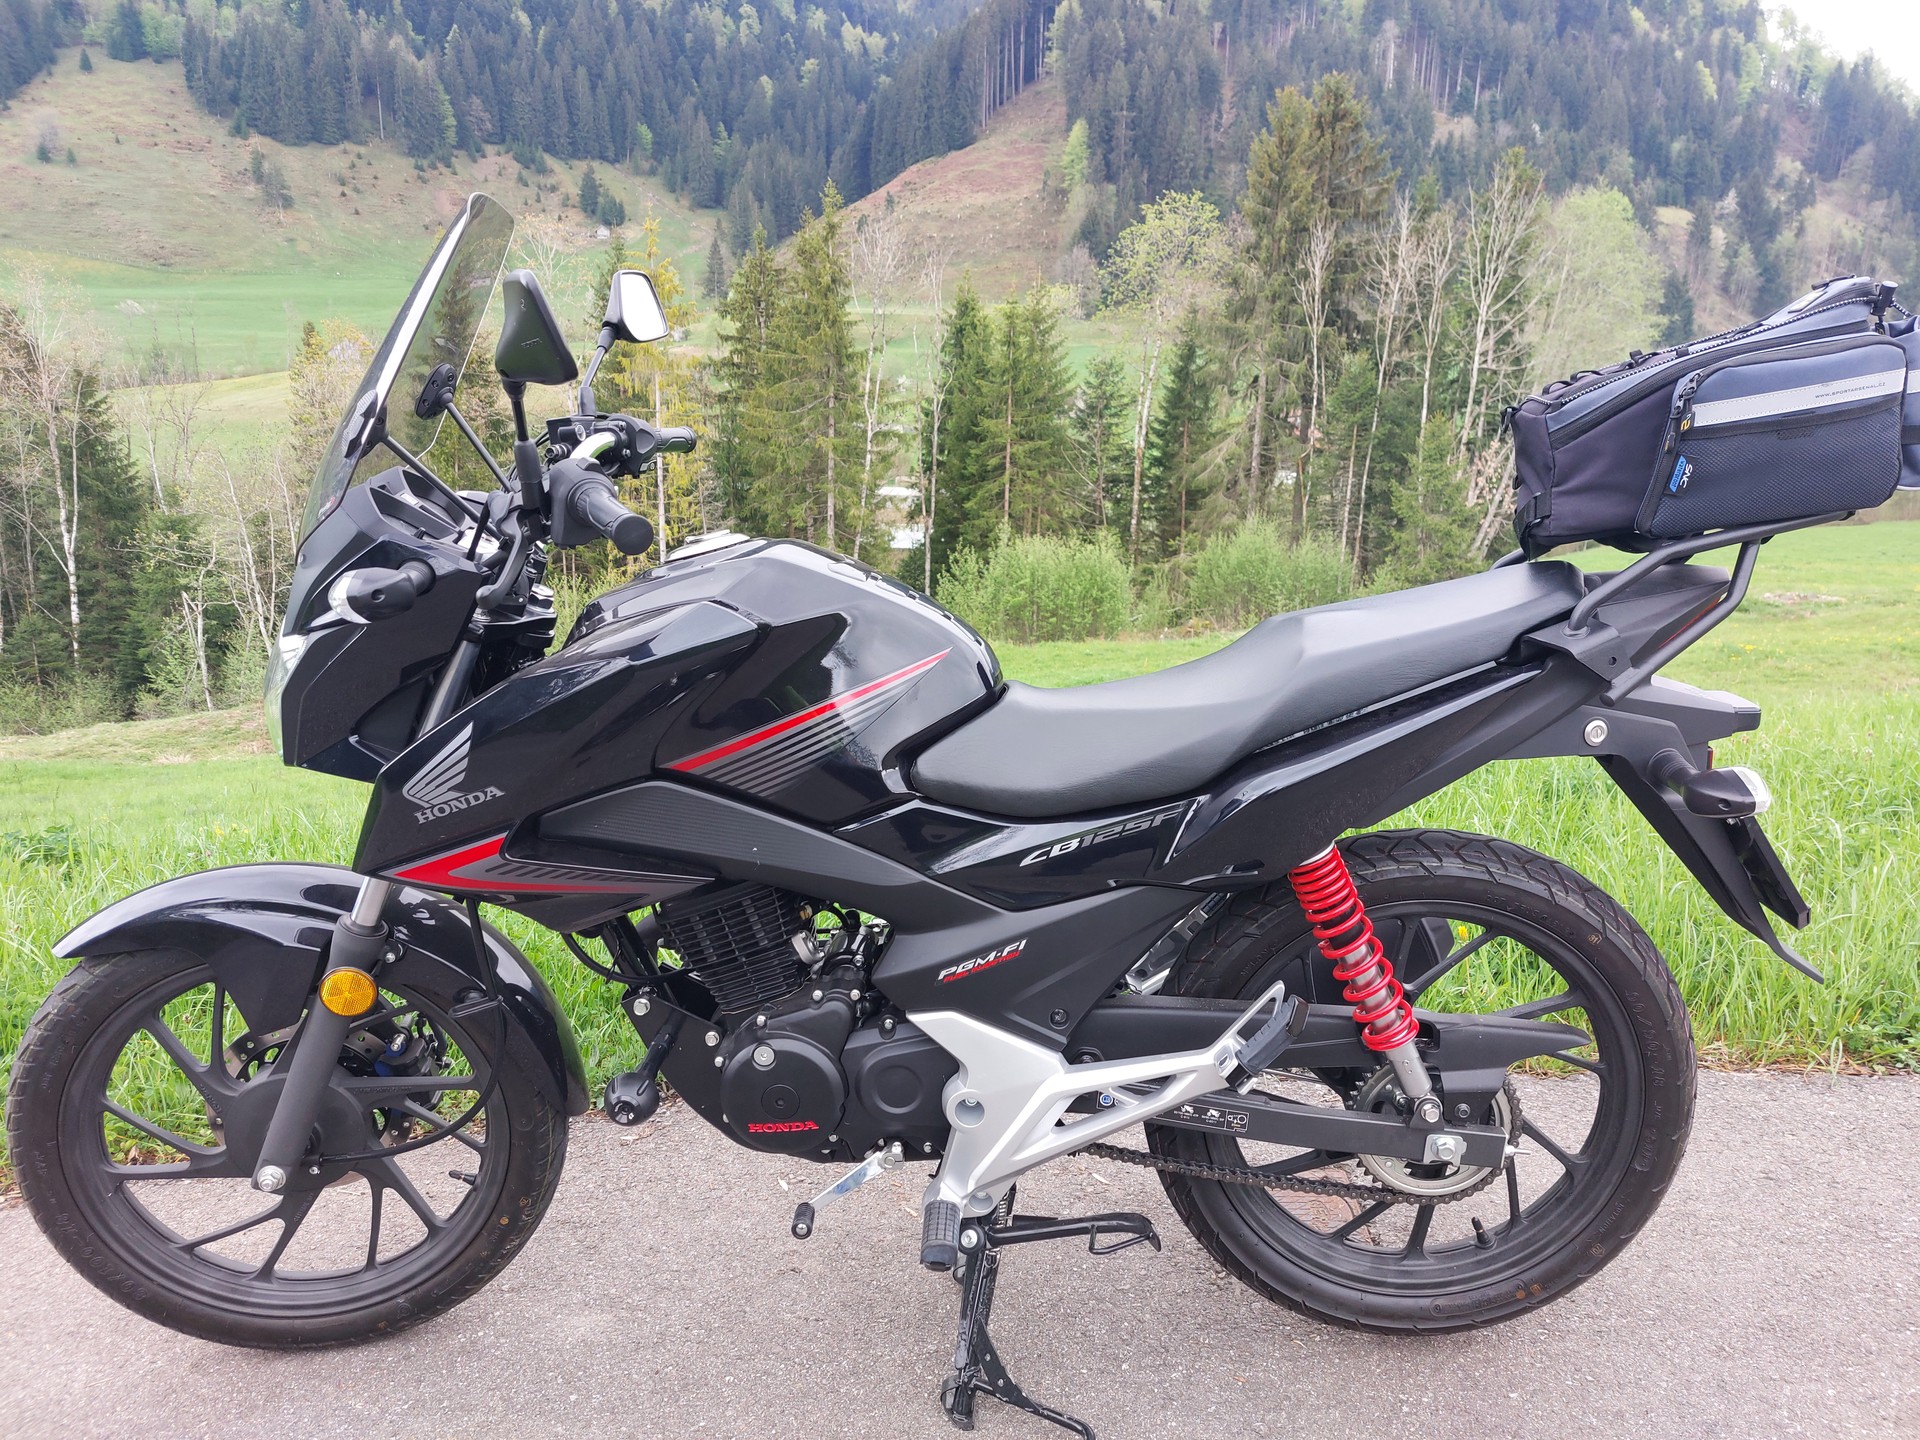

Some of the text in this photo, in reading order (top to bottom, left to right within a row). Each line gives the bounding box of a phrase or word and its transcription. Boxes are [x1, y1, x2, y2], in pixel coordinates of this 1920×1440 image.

[414, 786, 505, 825] HONDA
[1019, 806, 1184, 867] CB125F
[937, 938, 1028, 981] PGM-FI
[747, 1120, 820, 1133] HONDA
